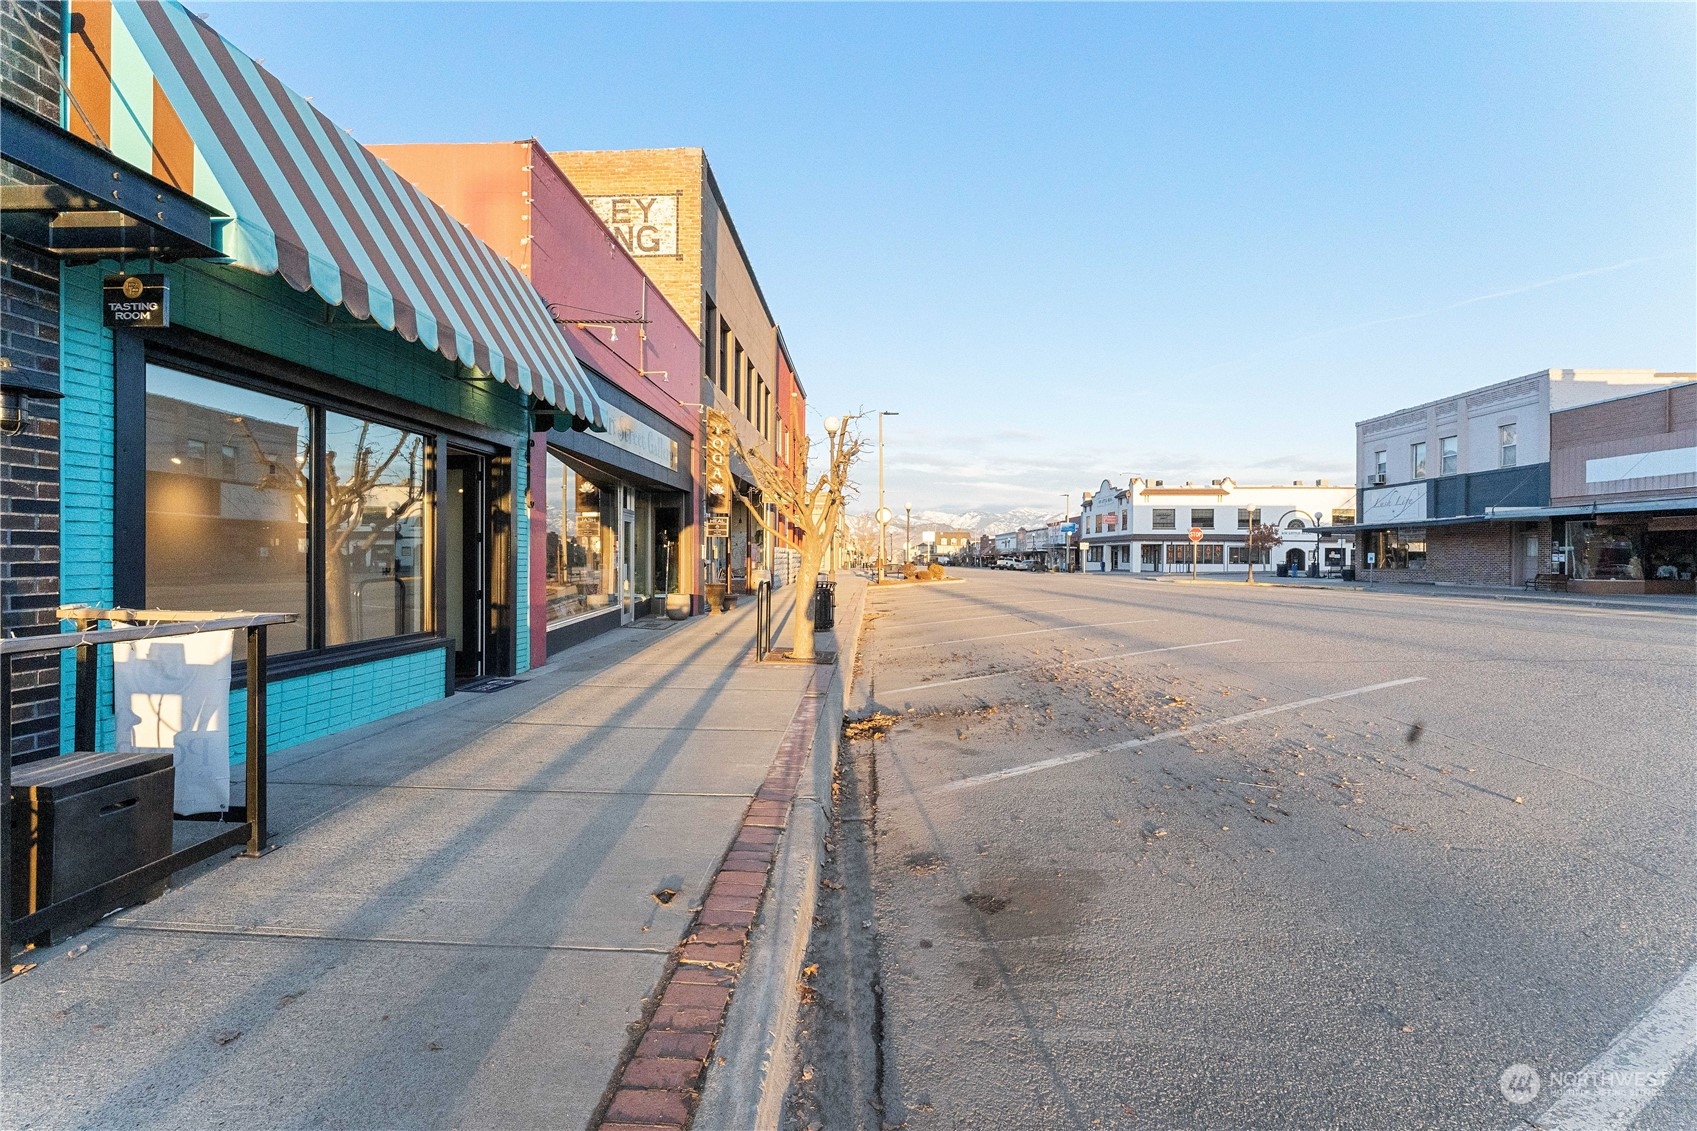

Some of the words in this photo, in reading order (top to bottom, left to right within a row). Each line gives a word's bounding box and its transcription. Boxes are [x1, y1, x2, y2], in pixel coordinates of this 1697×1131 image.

[108, 302, 158, 311] TASTING
[115, 312, 151, 320] ROOM
[712, 424, 724, 479] YOGA
